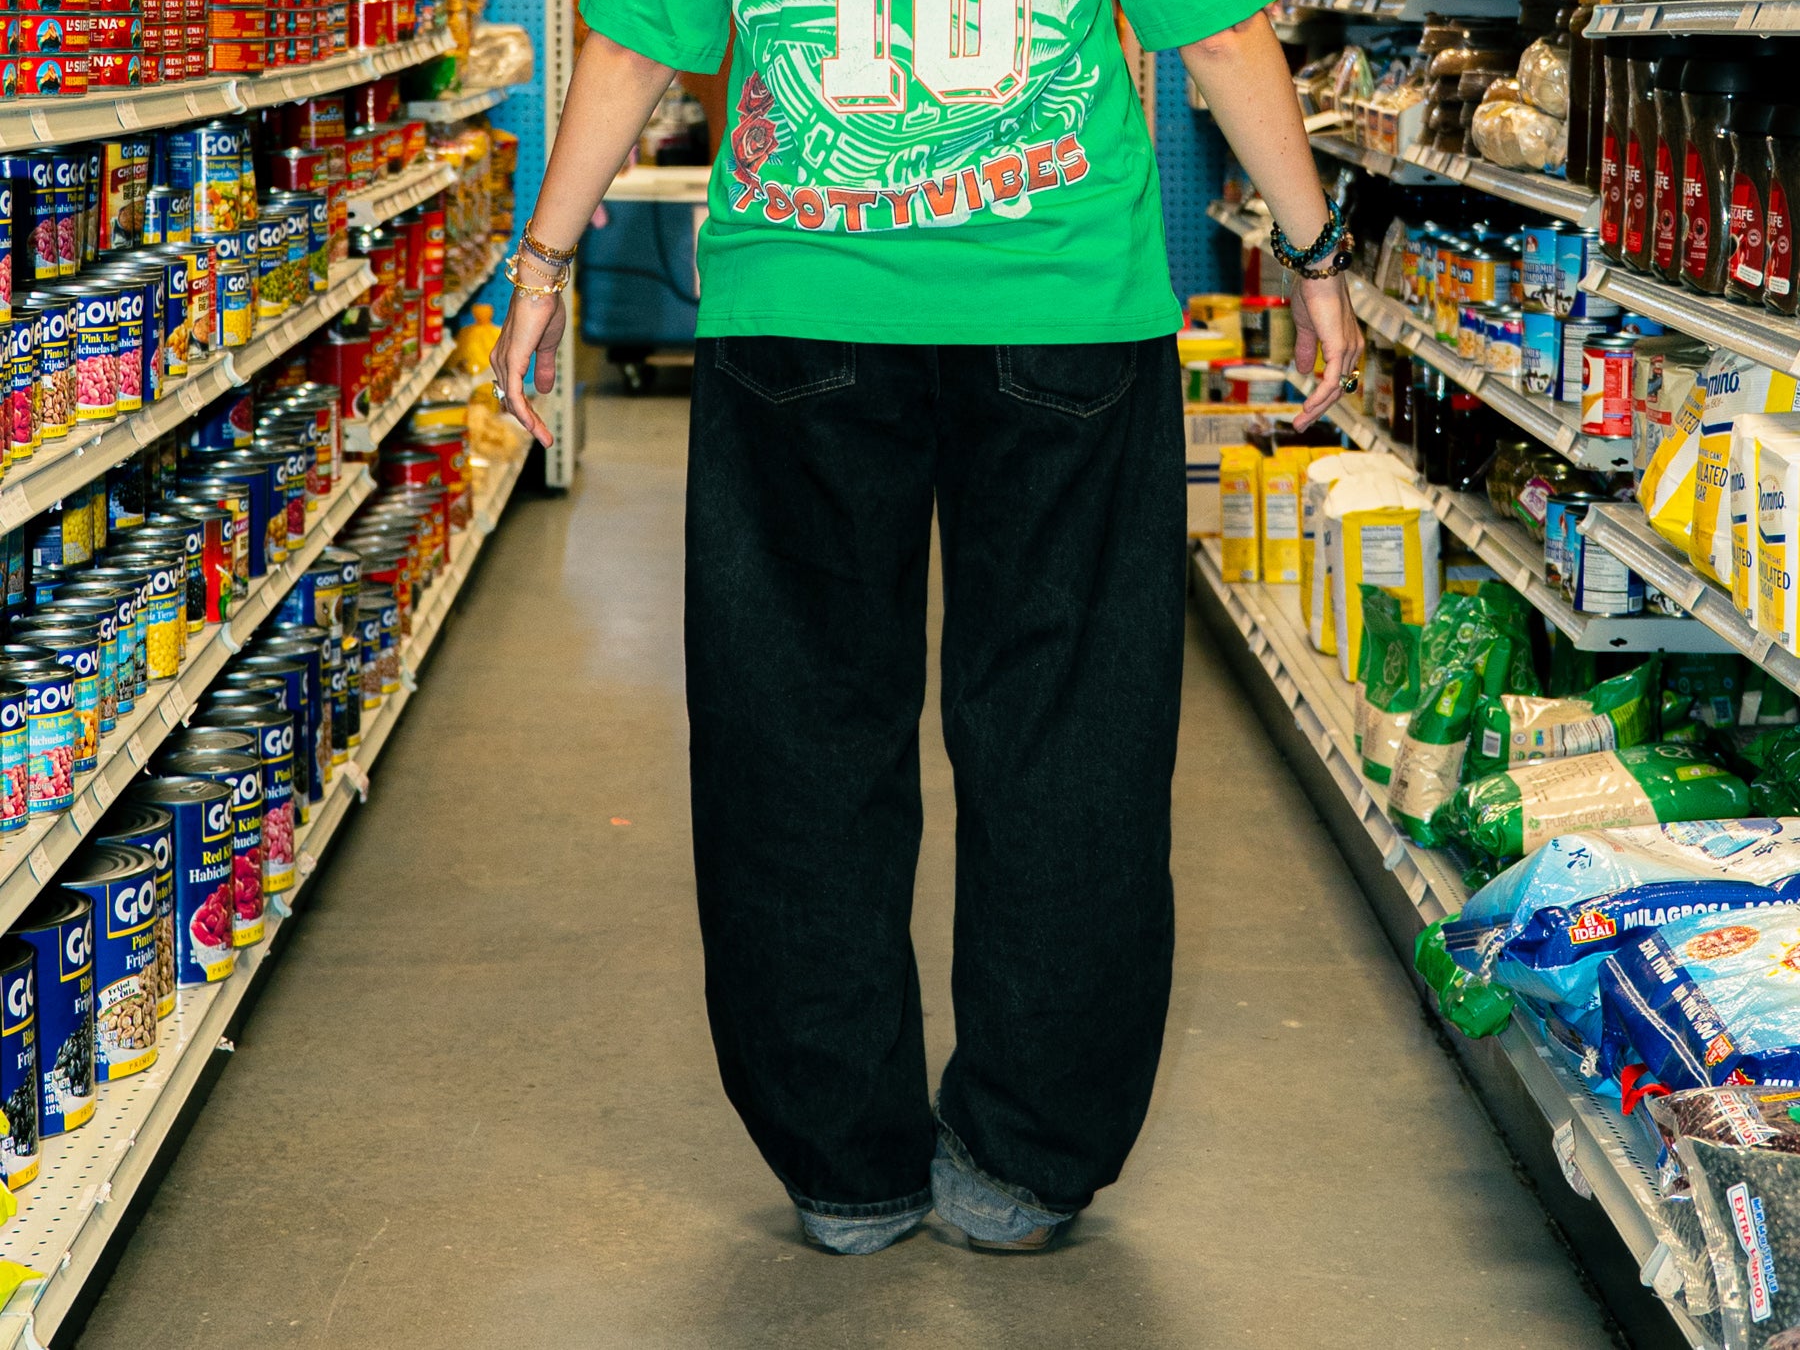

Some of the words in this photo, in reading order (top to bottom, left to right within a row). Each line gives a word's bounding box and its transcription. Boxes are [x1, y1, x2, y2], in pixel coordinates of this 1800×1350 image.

[82, 334, 102, 343] Pink
[202, 849, 220, 866] Red
[1584, 915, 1599, 927] EL
[1574, 924, 1613, 942] IDEAL
[1733, 1196, 1751, 1247] EXTRA
